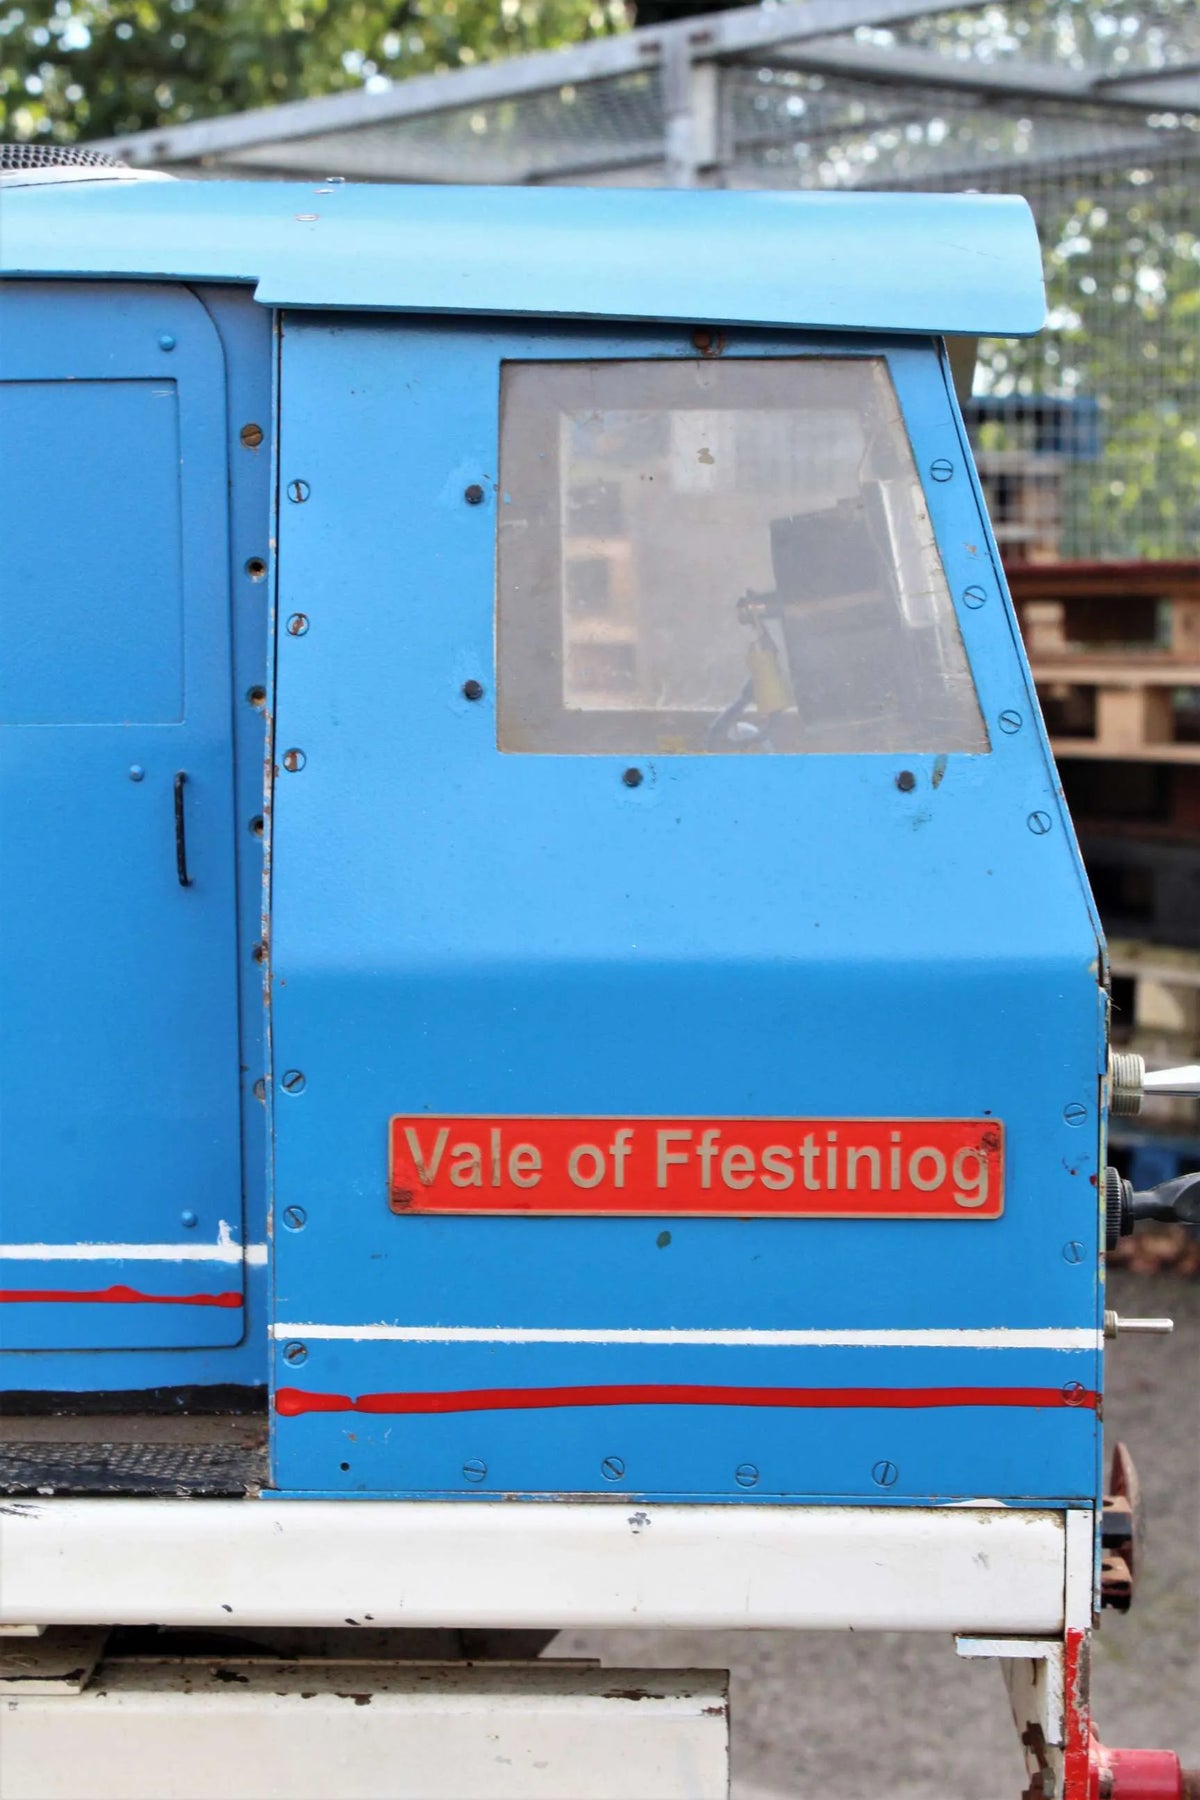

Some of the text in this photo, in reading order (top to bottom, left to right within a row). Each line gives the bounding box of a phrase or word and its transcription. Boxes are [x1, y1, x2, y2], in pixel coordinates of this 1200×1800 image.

[404, 1127, 990, 1208] Vale of Ffestiniog
